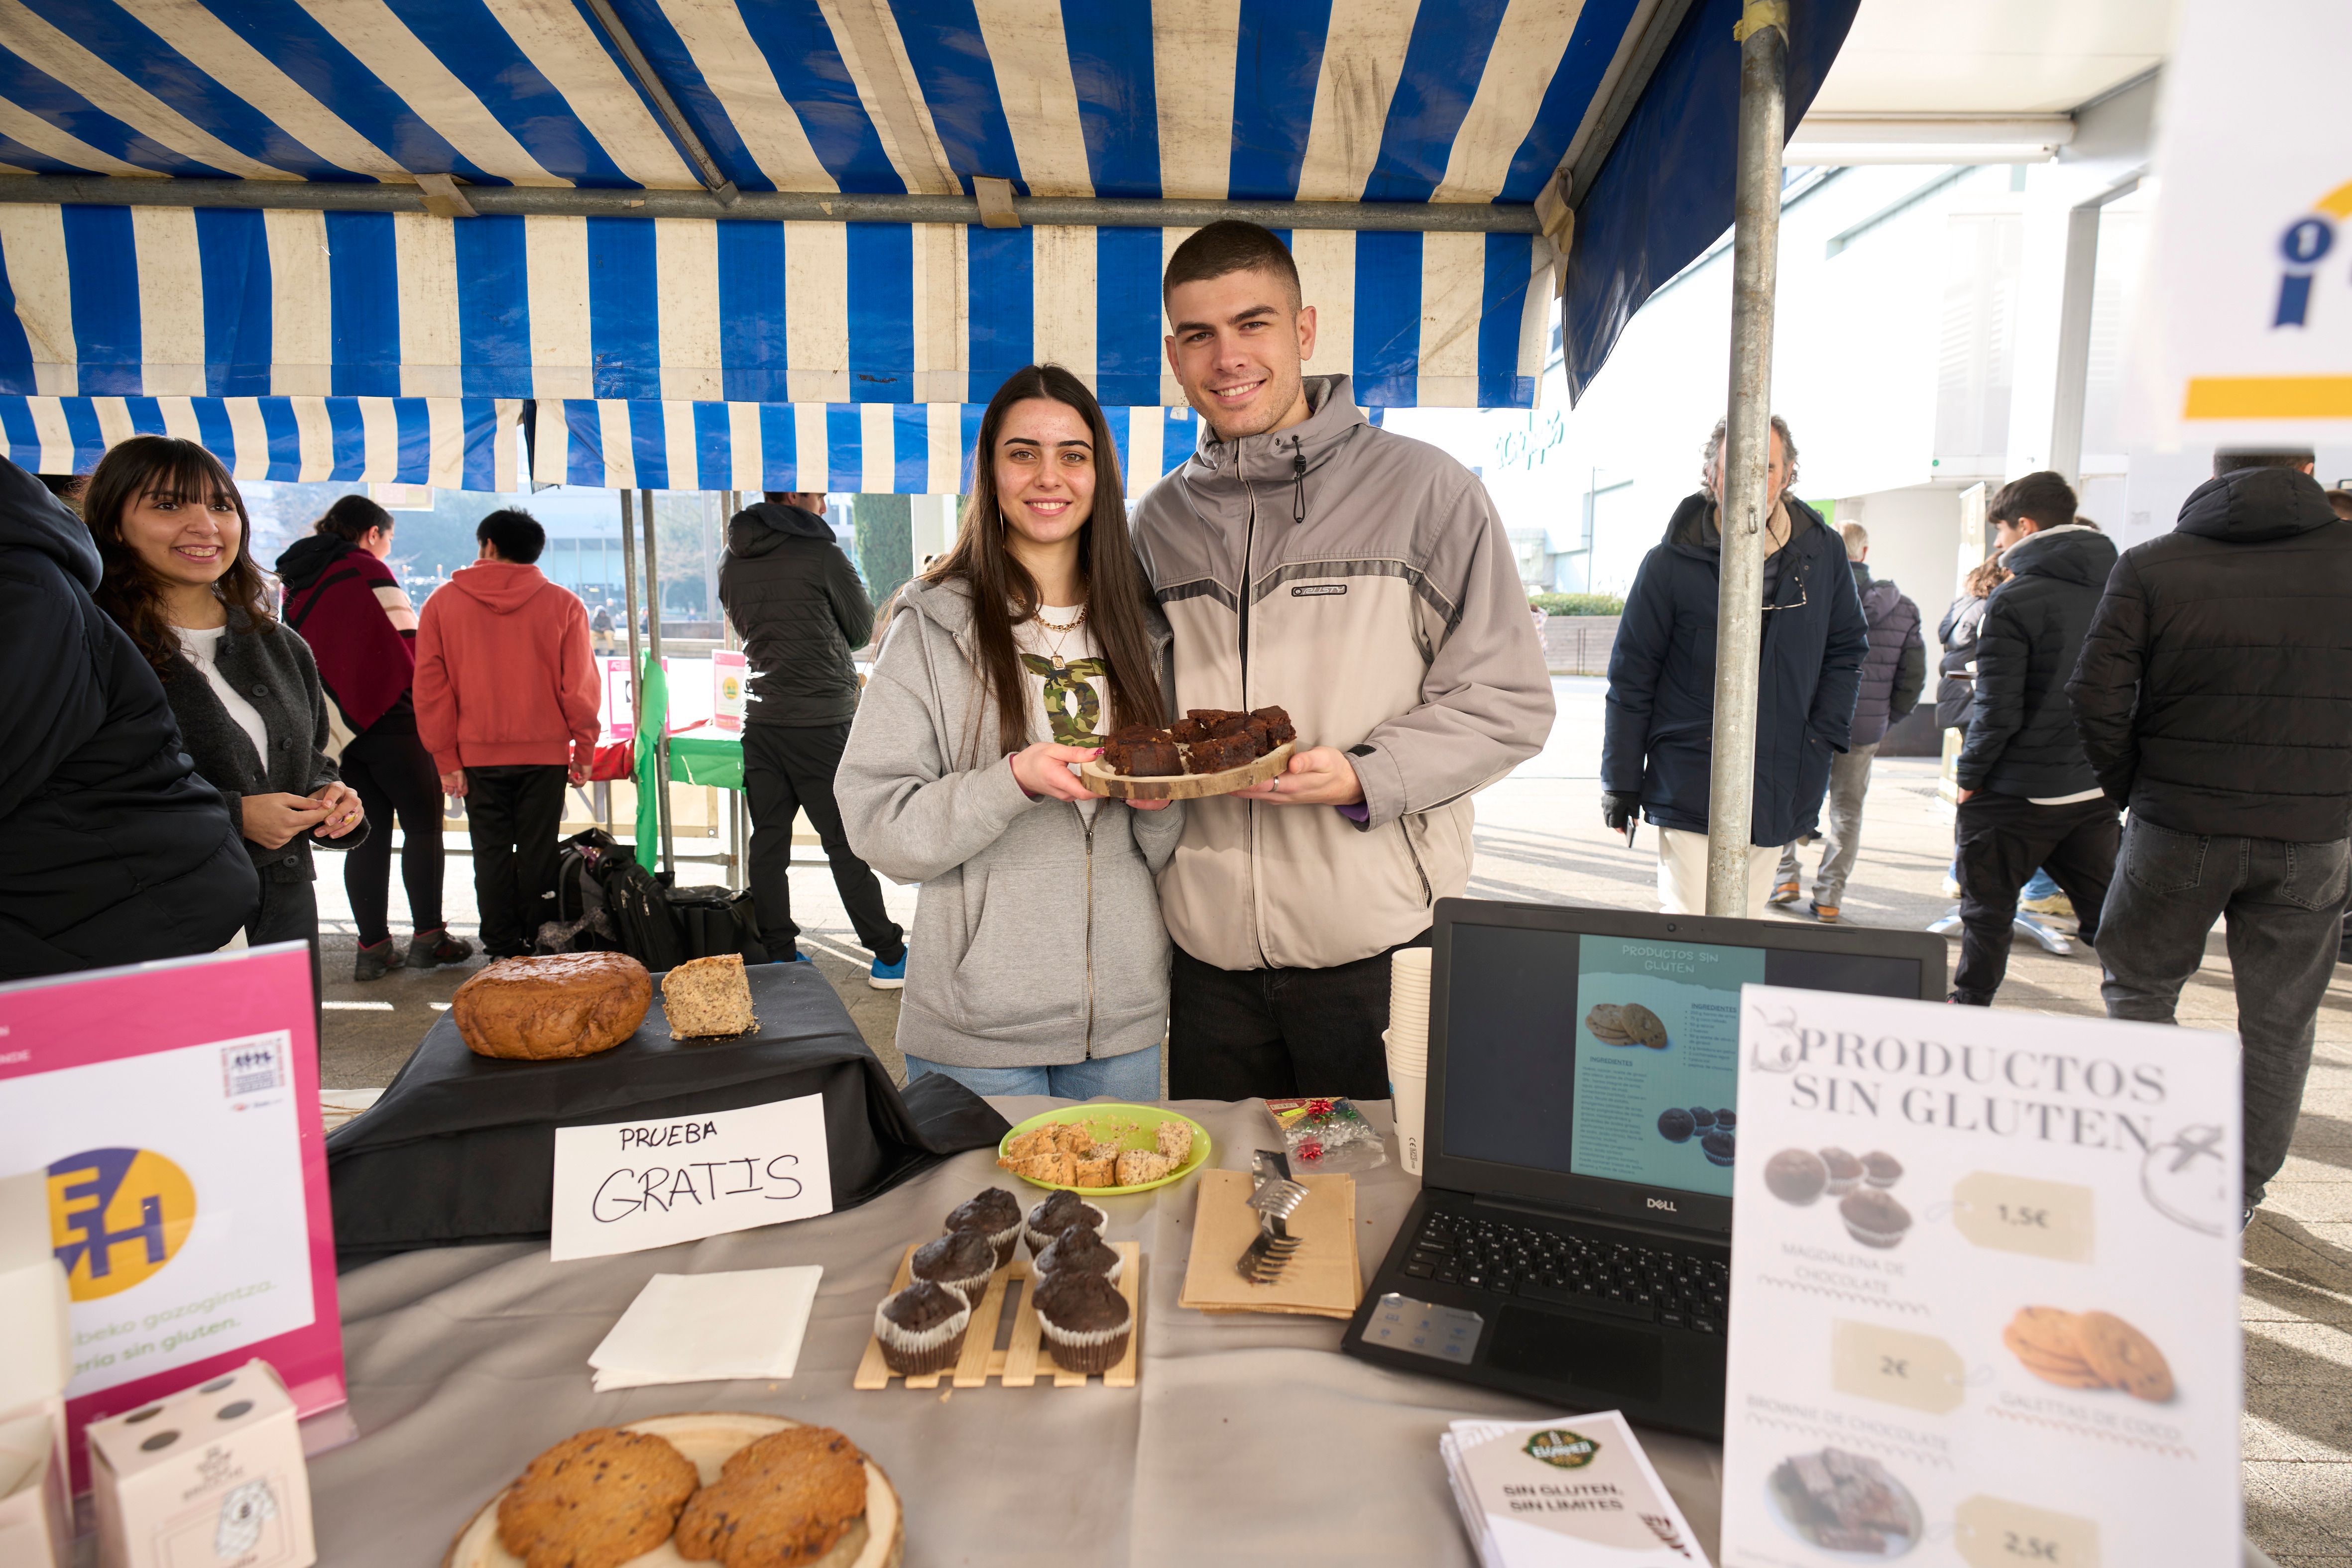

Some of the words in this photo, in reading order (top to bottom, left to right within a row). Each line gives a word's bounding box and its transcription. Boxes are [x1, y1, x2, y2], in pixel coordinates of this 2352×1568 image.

[1302, 586, 1344, 595] RUSTY
[1623, 945, 1694, 960] PRODUCTOS
[1699, 950, 1719, 963] SIN
[1645, 960, 1695, 973] GLUTEN
[1691, 1004, 1737, 1012] INGREDIENTES
[1590, 1056, 1633, 1066] INGREDIENTES
[1798, 1027, 2166, 1104] PRODUCTOS
[1791, 1074, 1882, 1117] SIN
[1901, 1088, 2153, 1153] GLUTEN
[620, 1121, 717, 1151] PRUEBA
[592, 1154, 803, 1223] GRATIS
[1646, 1198, 1677, 1213] DELL
[1996, 1203, 2051, 1230] 1,5€
[1781, 1242, 1882, 1271] MAGDALENA
[1884, 1261, 1905, 1277] DE
[1793, 1264, 1890, 1294] CHOCOLATE
[161, 1318, 241, 1351] gluten.
[1879, 1355, 1910, 1379] 2€
[1746, 1393, 1818, 1420] BROWNIE
[1823, 1409, 1844, 1425] DE
[1848, 1416, 1949, 1450] CHOCOLATE
[1503, 1483, 1535, 1497] SIN
[1510, 1500, 1542, 1513] SIN
[2002, 1530, 2061, 1563] 2,5€
